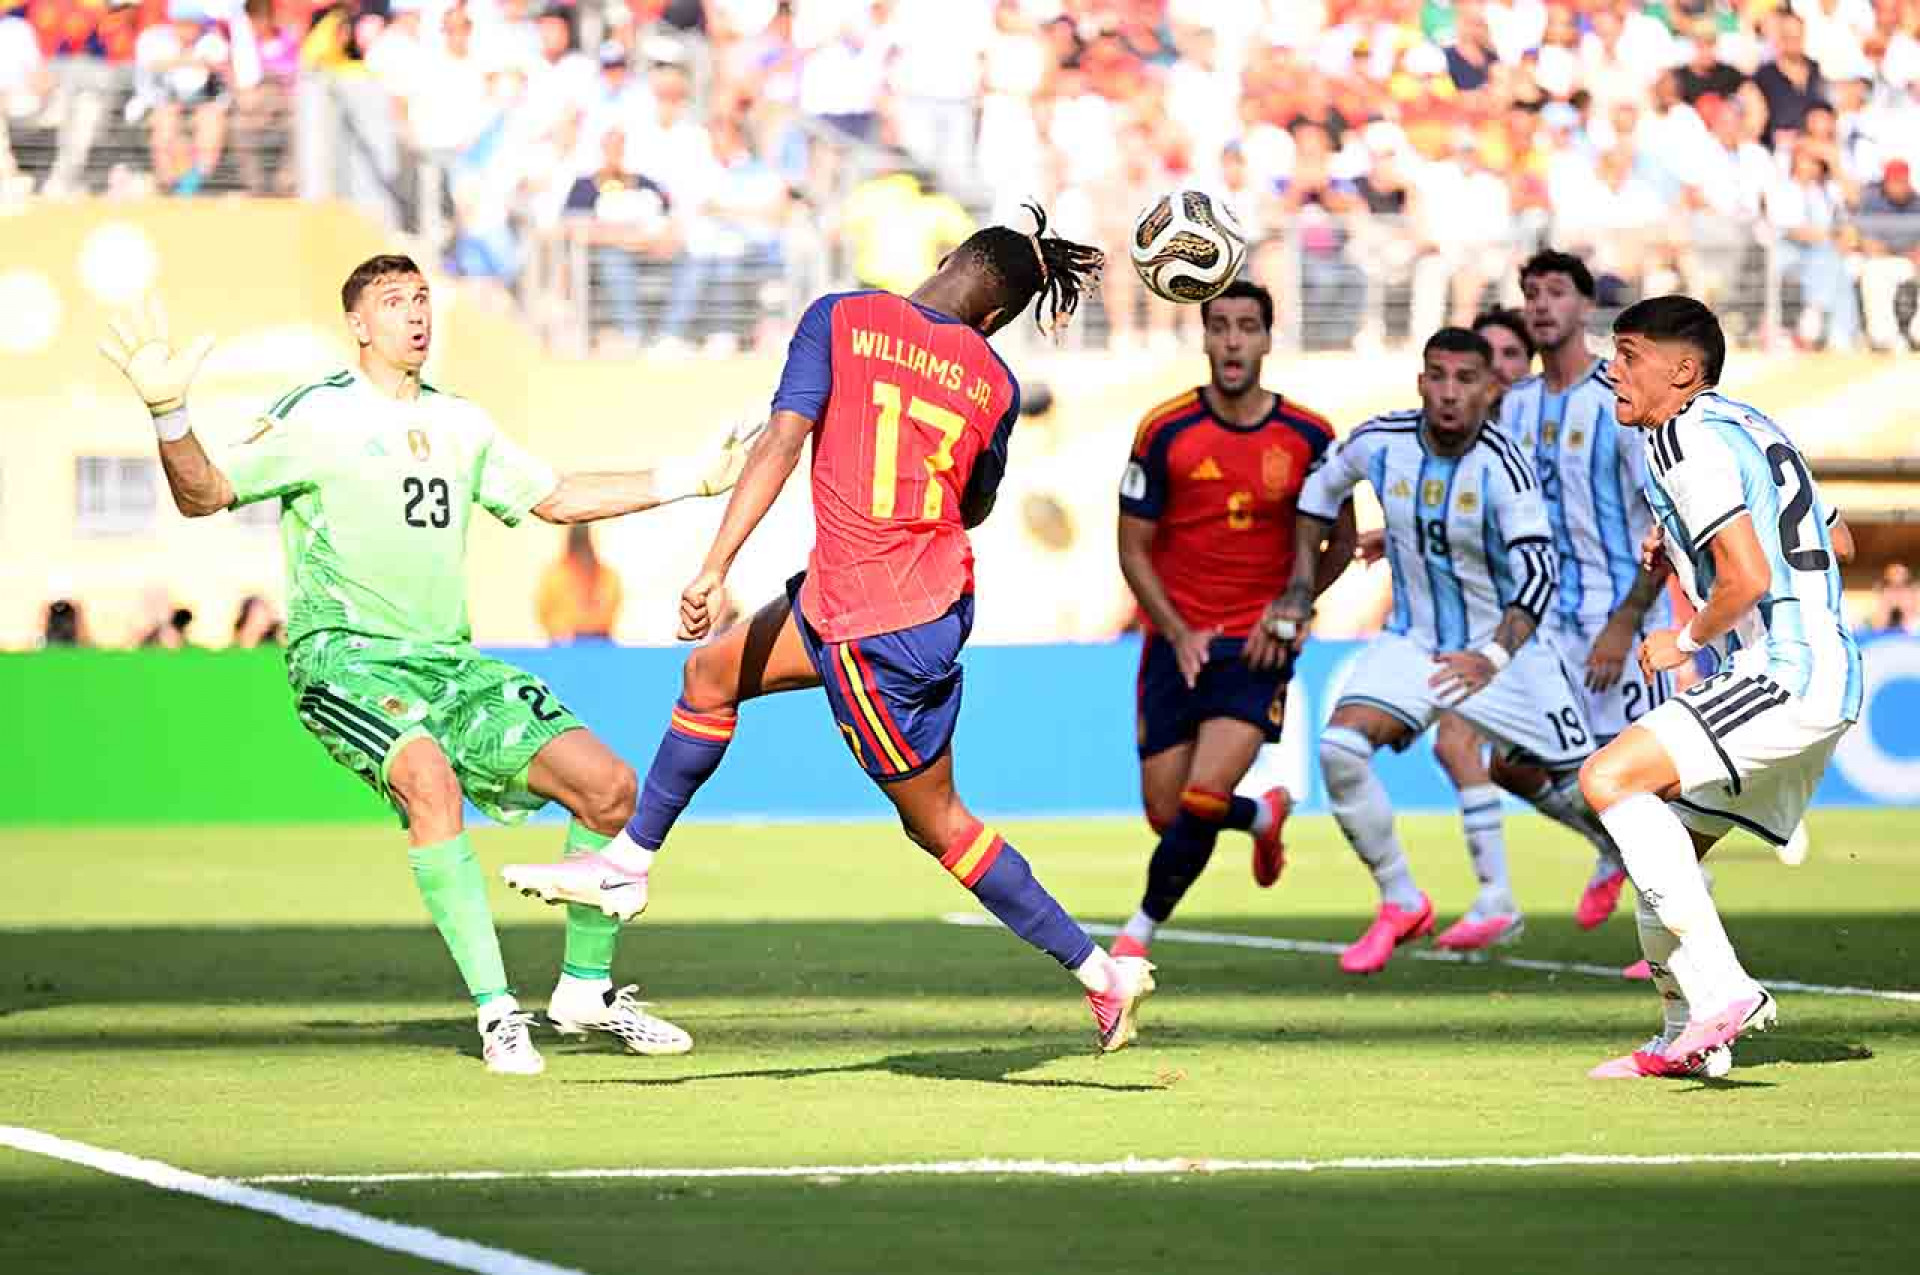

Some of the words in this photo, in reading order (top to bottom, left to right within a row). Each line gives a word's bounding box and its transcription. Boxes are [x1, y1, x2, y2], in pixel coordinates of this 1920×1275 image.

[852, 327, 964, 391] WILLIAMS
[872, 381, 967, 519] 17
[403, 476, 450, 528] 23
[1227, 491, 1253, 530] 6
[1415, 515, 1451, 556] 19
[1545, 706, 1588, 751] 19
